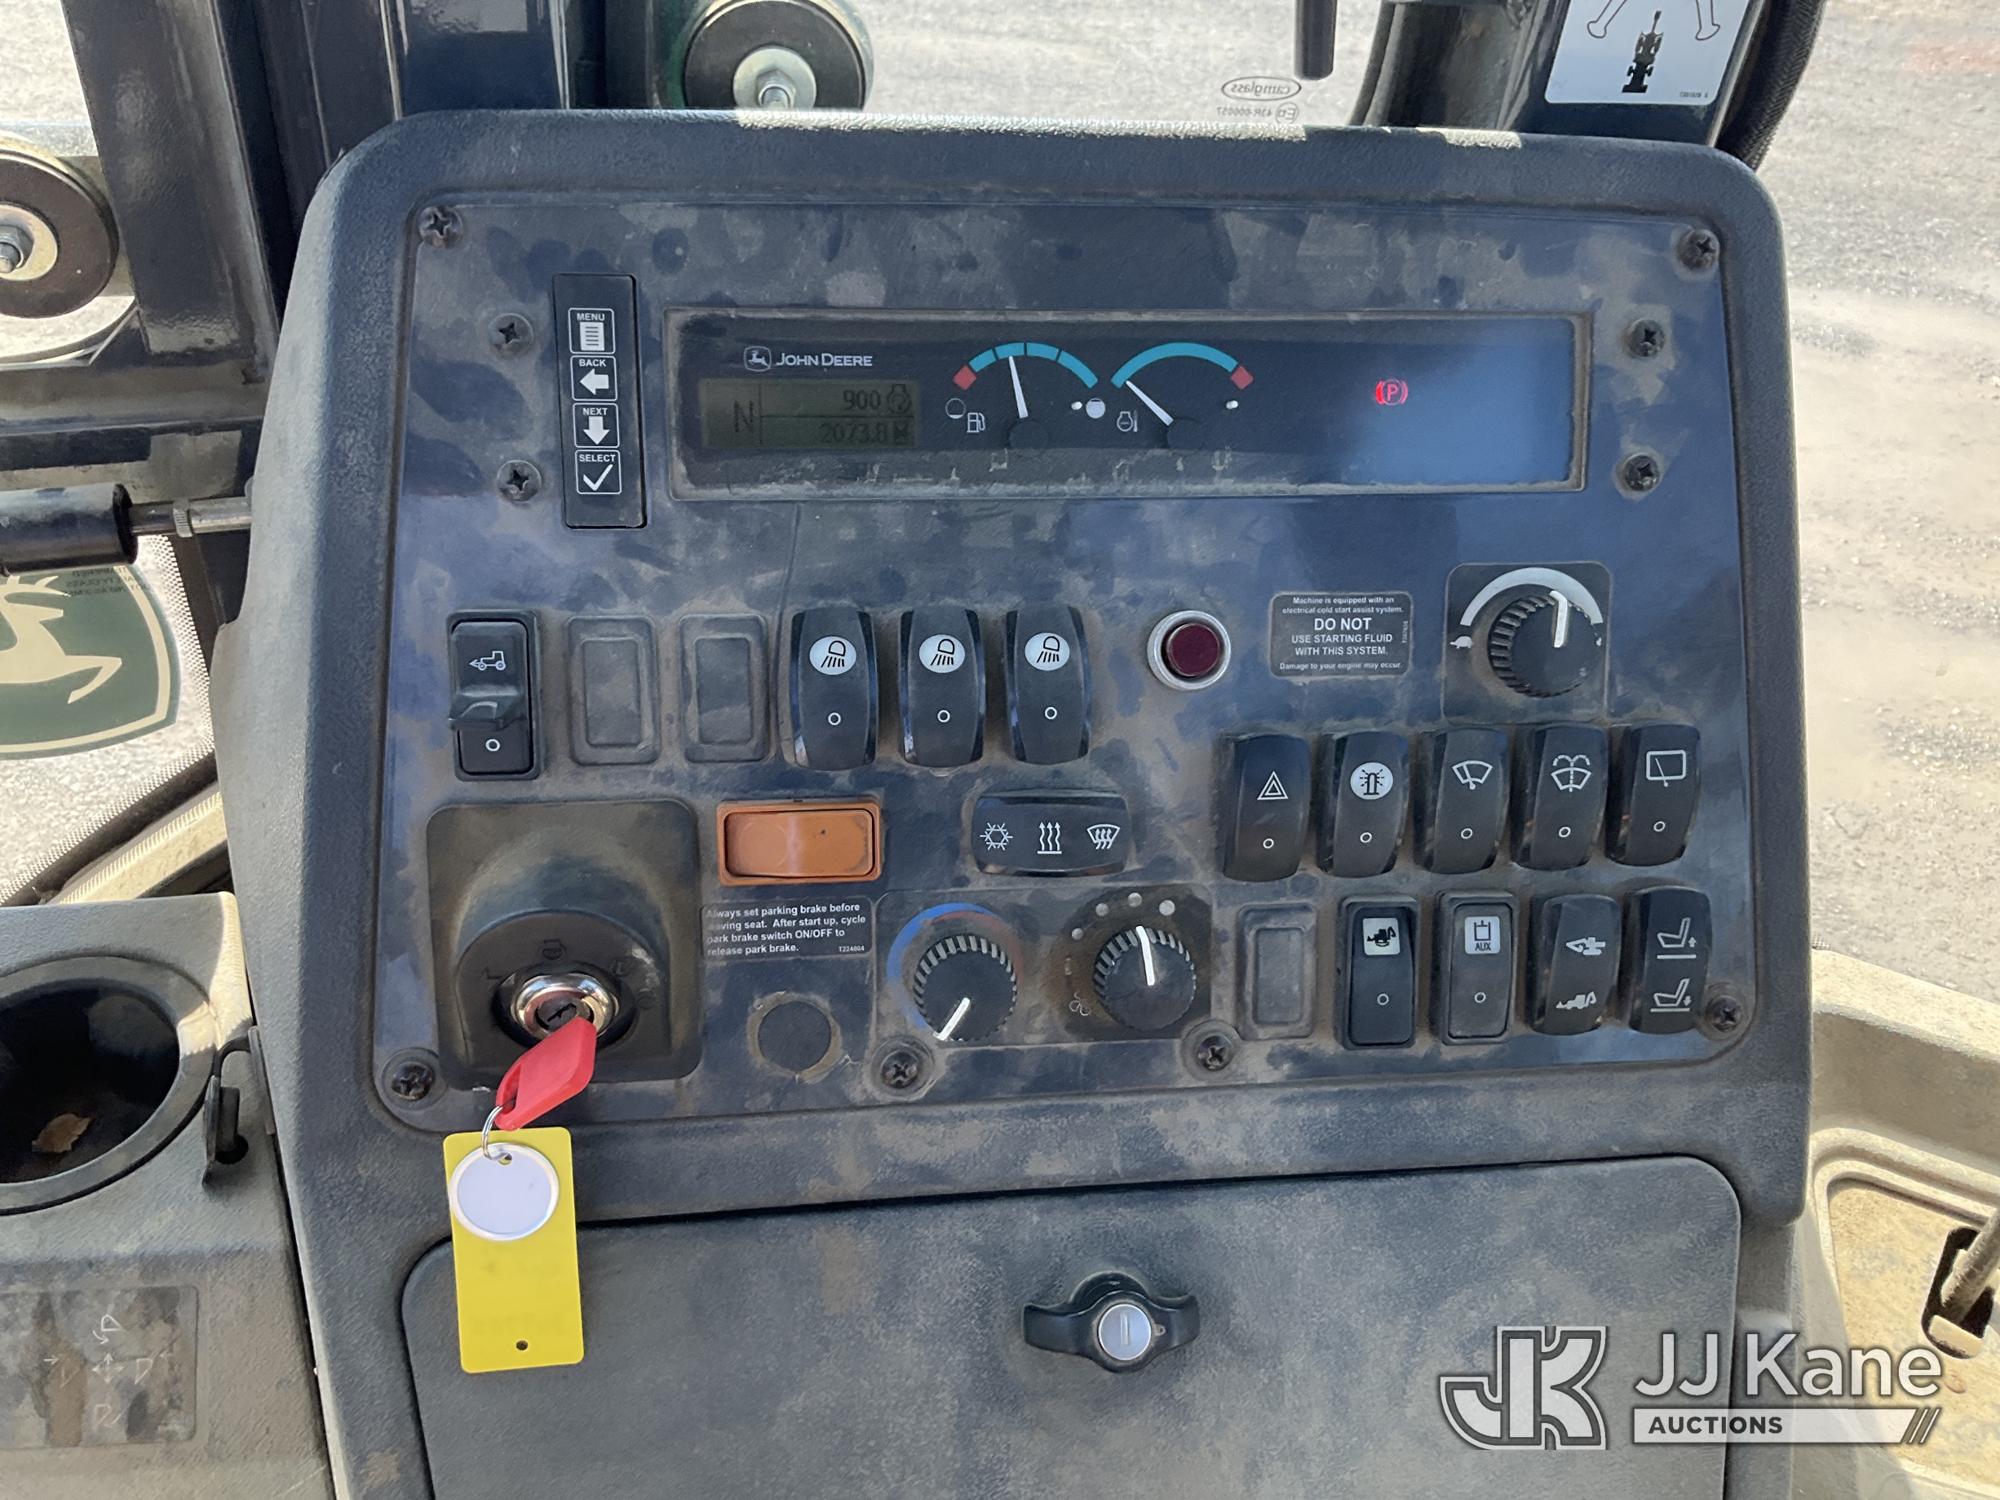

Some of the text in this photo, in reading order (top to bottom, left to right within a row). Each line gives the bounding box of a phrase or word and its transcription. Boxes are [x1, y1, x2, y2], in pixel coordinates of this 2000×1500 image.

[577, 313, 605, 321] MENU
[579, 359, 606, 367] BACK
[776, 352, 873, 367] JOHN DEERE
[843, 390, 881, 410] 900
[582, 408, 608, 416] NEXT
[734, 399, 754, 433] N
[579, 454, 616, 462] SELECT
[1333, 597, 1366, 606] equipped
[1376, 606, 1404, 615] system.
[1314, 618, 1372, 631] DO NOT
[1291, 634, 1393, 643] USE STARTING FLUID
[1295, 646, 1388, 656] WITH THIS SYSTEM.
[1280, 662, 1309, 671] Damage
[1337, 663, 1361, 671] engine
[1364, 663, 1378, 671] may
[706, 903, 860, 919] Always set parking brake before
[706, 921, 742, 931] ving
[744, 920, 768, 929] seat.
[773, 919, 796, 928] After
[799, 917, 821, 926] start
[841, 915, 866, 925] cycle
[706, 929, 845, 944] park brake switch ON/OFF to
[706, 946, 743, 956] release
[745, 944, 767, 955] park
[769, 943, 799, 953] brake.
[1475, 942, 1491, 951] AUX
